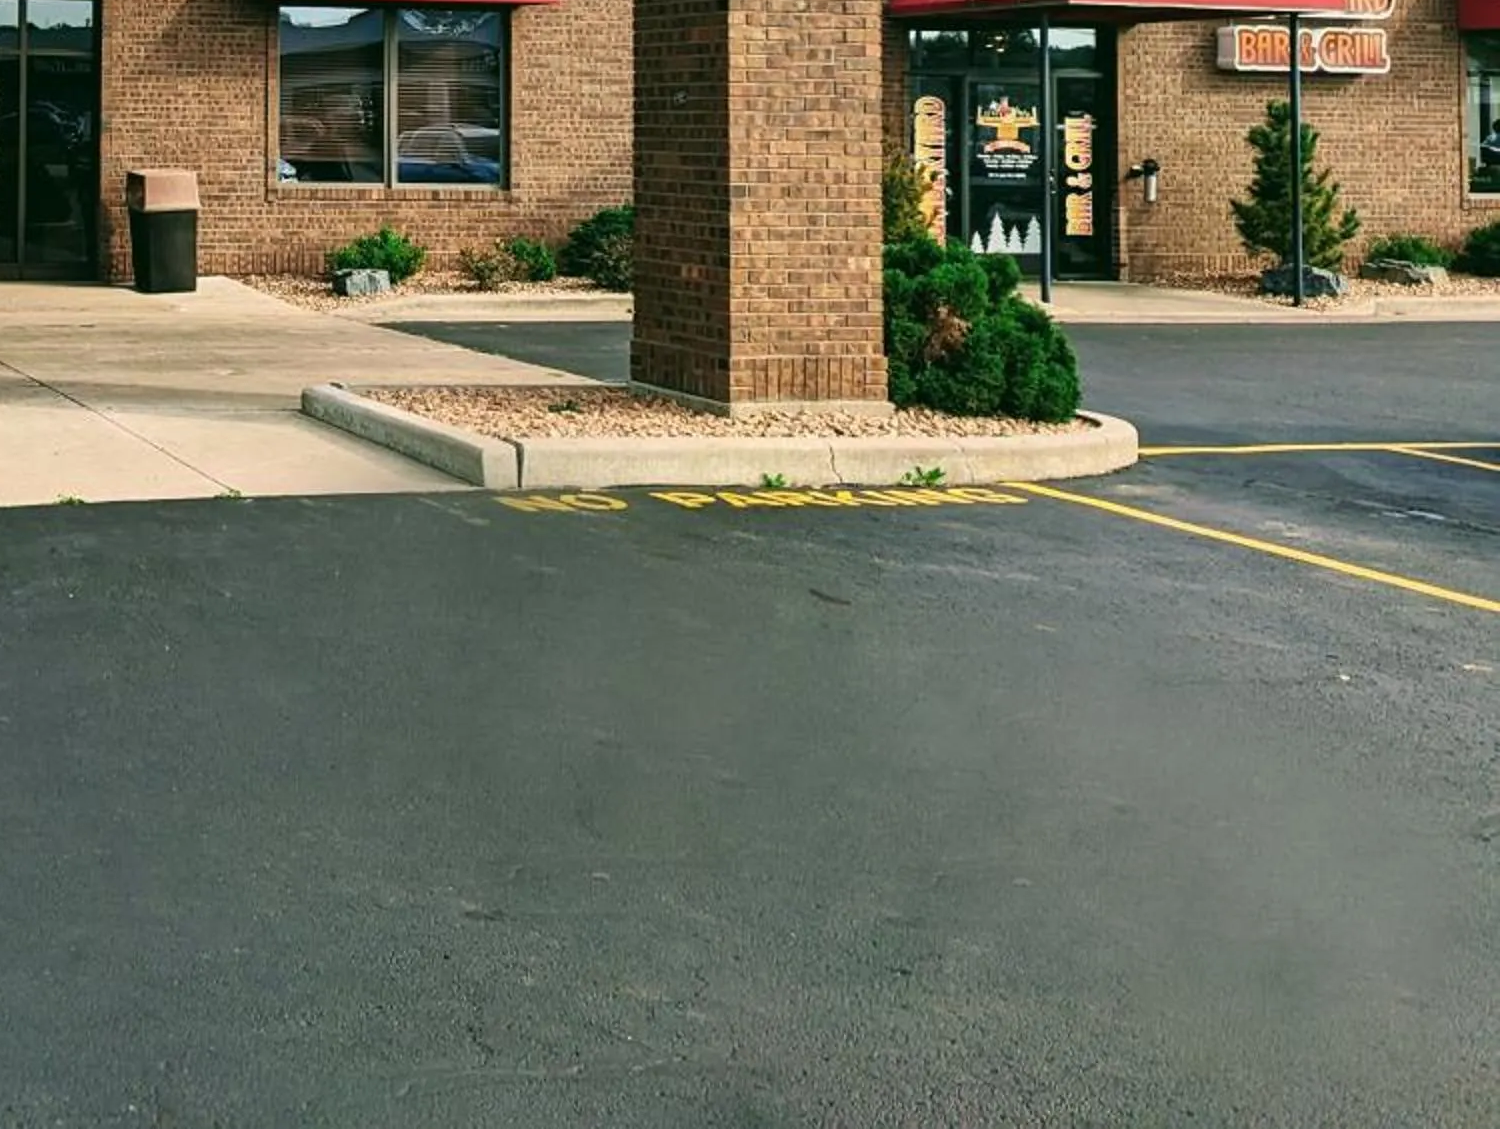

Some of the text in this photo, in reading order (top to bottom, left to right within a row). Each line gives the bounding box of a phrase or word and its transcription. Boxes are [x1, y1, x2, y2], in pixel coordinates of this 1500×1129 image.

[1240, 30, 1290, 65] BAR
[1320, 32, 1386, 67] GRILL
[1066, 191, 1092, 235] BAR
